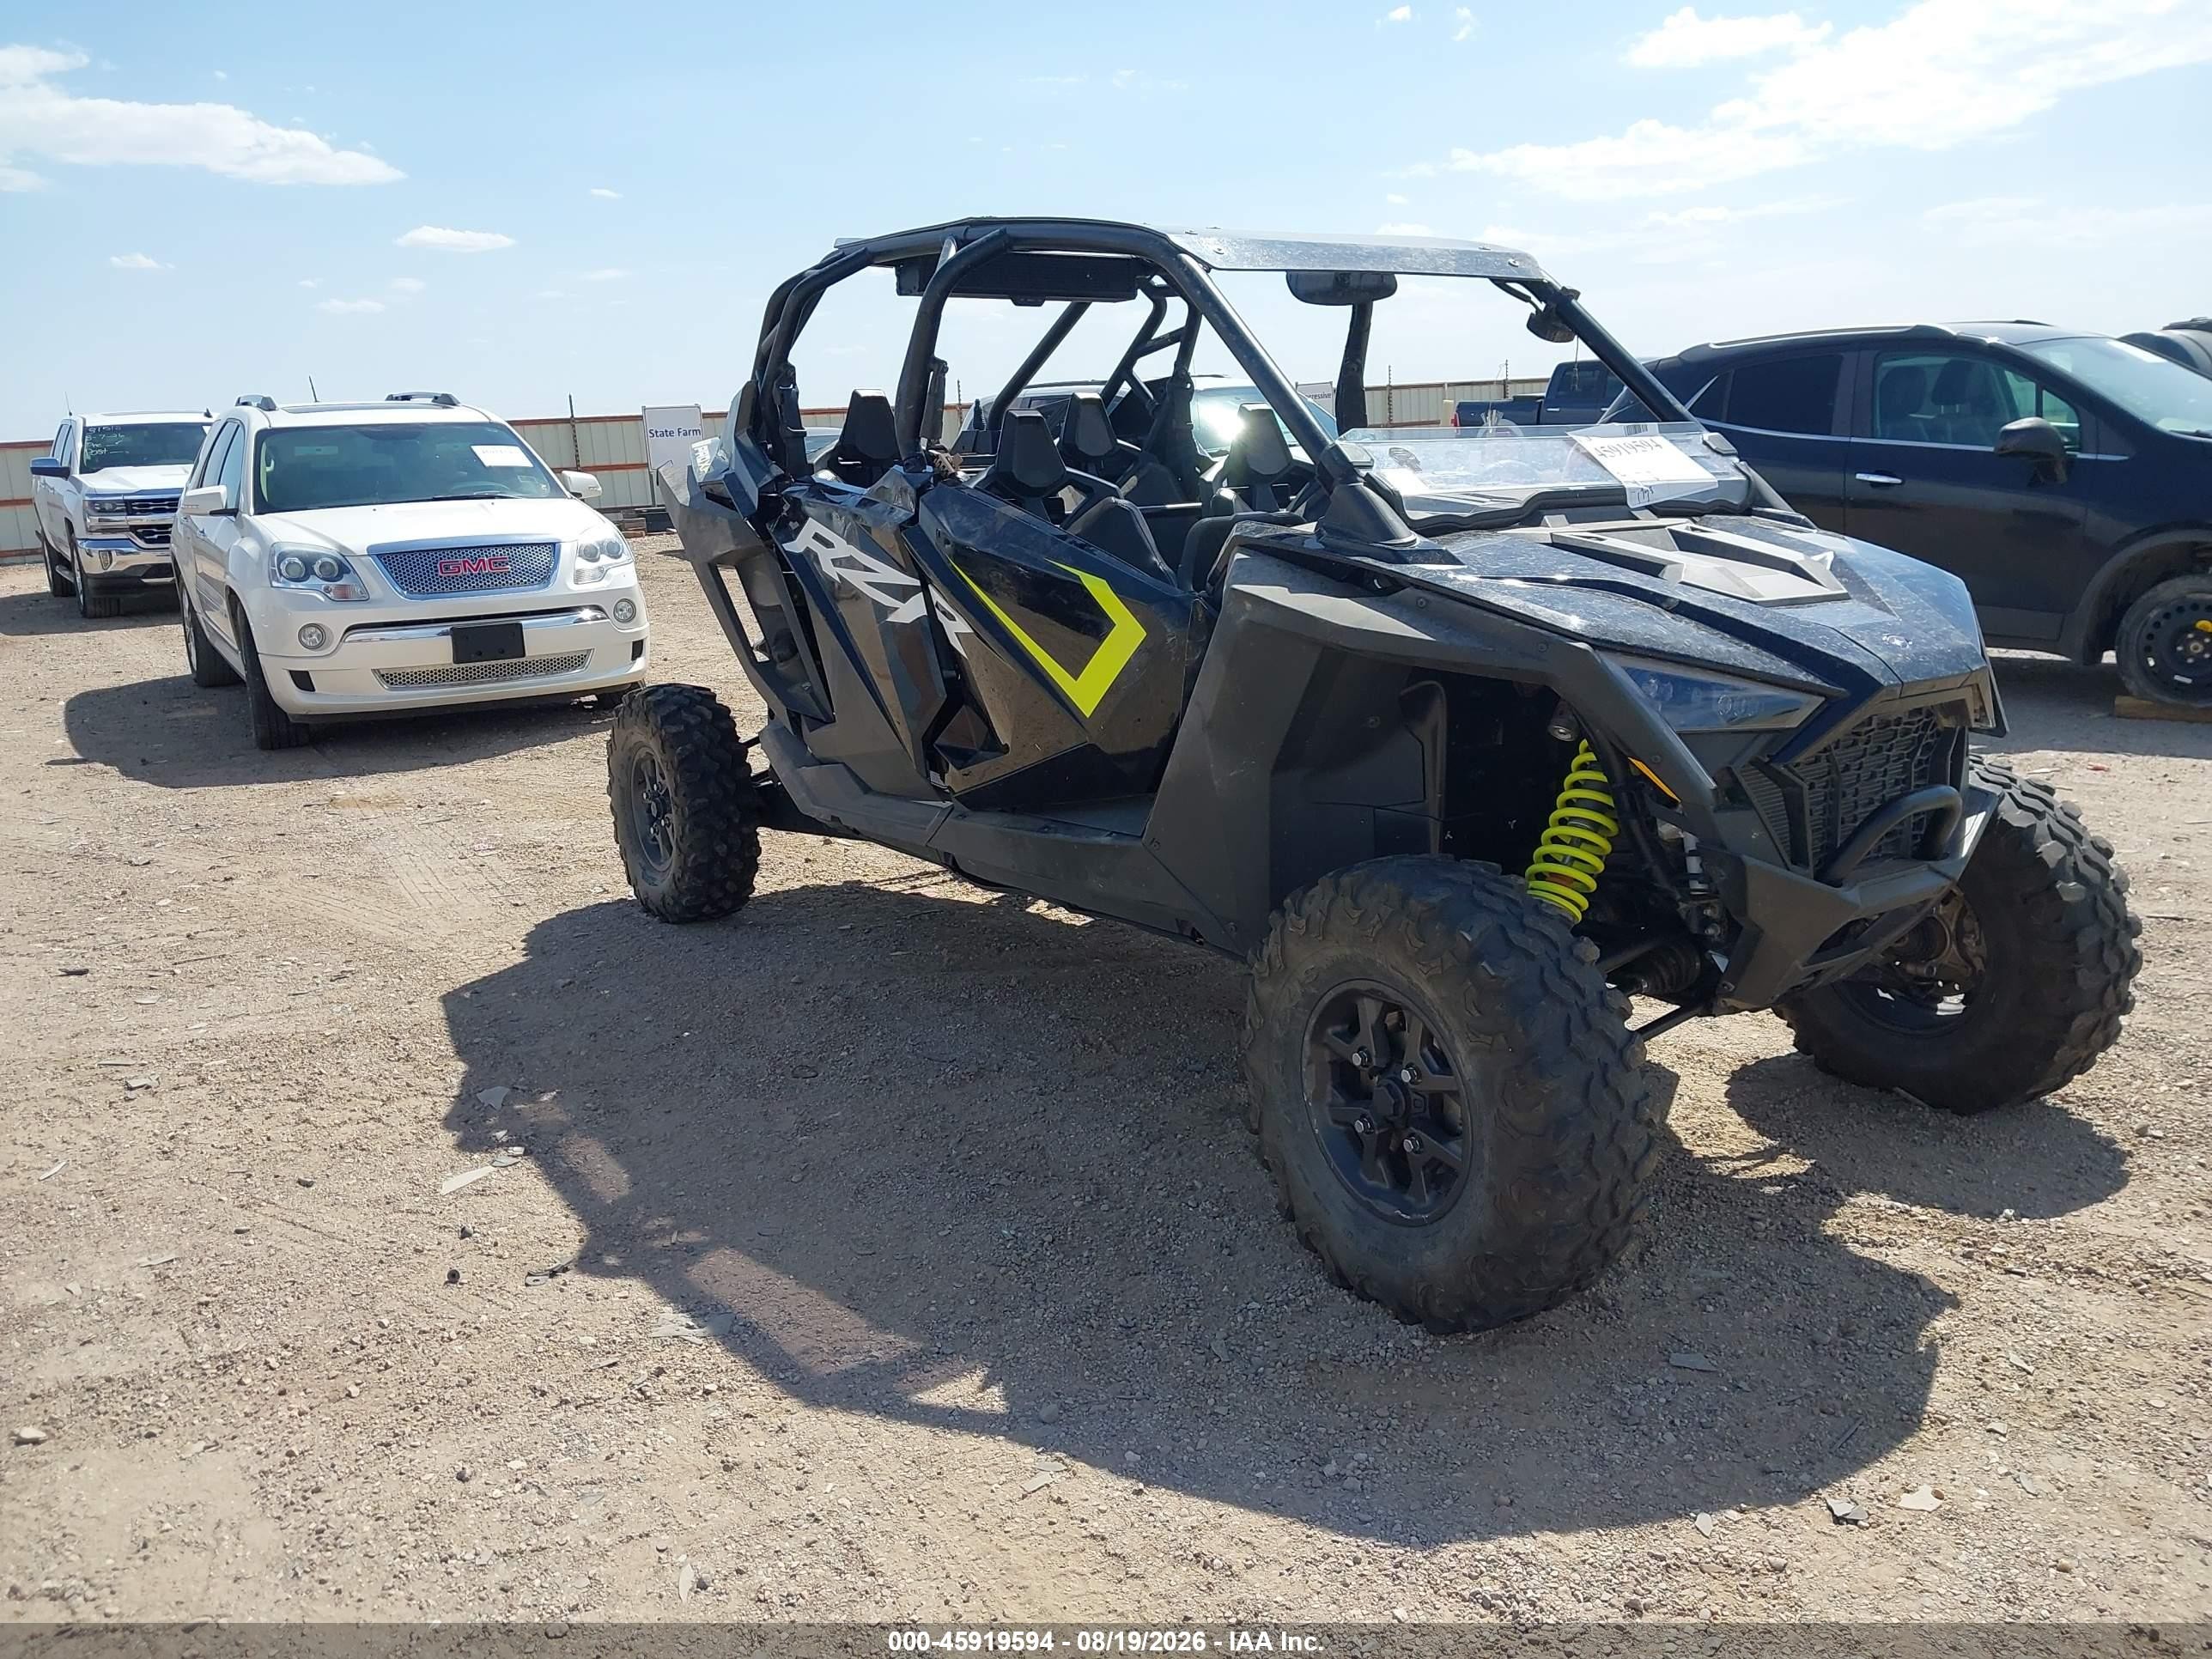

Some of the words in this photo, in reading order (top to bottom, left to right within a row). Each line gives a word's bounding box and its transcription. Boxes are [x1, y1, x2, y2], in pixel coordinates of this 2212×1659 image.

[648, 428, 675, 438] State
[677, 428, 702, 437] Farm
[1594, 438, 1663, 459] 45919594
[438, 556, 509, 576] GMC
